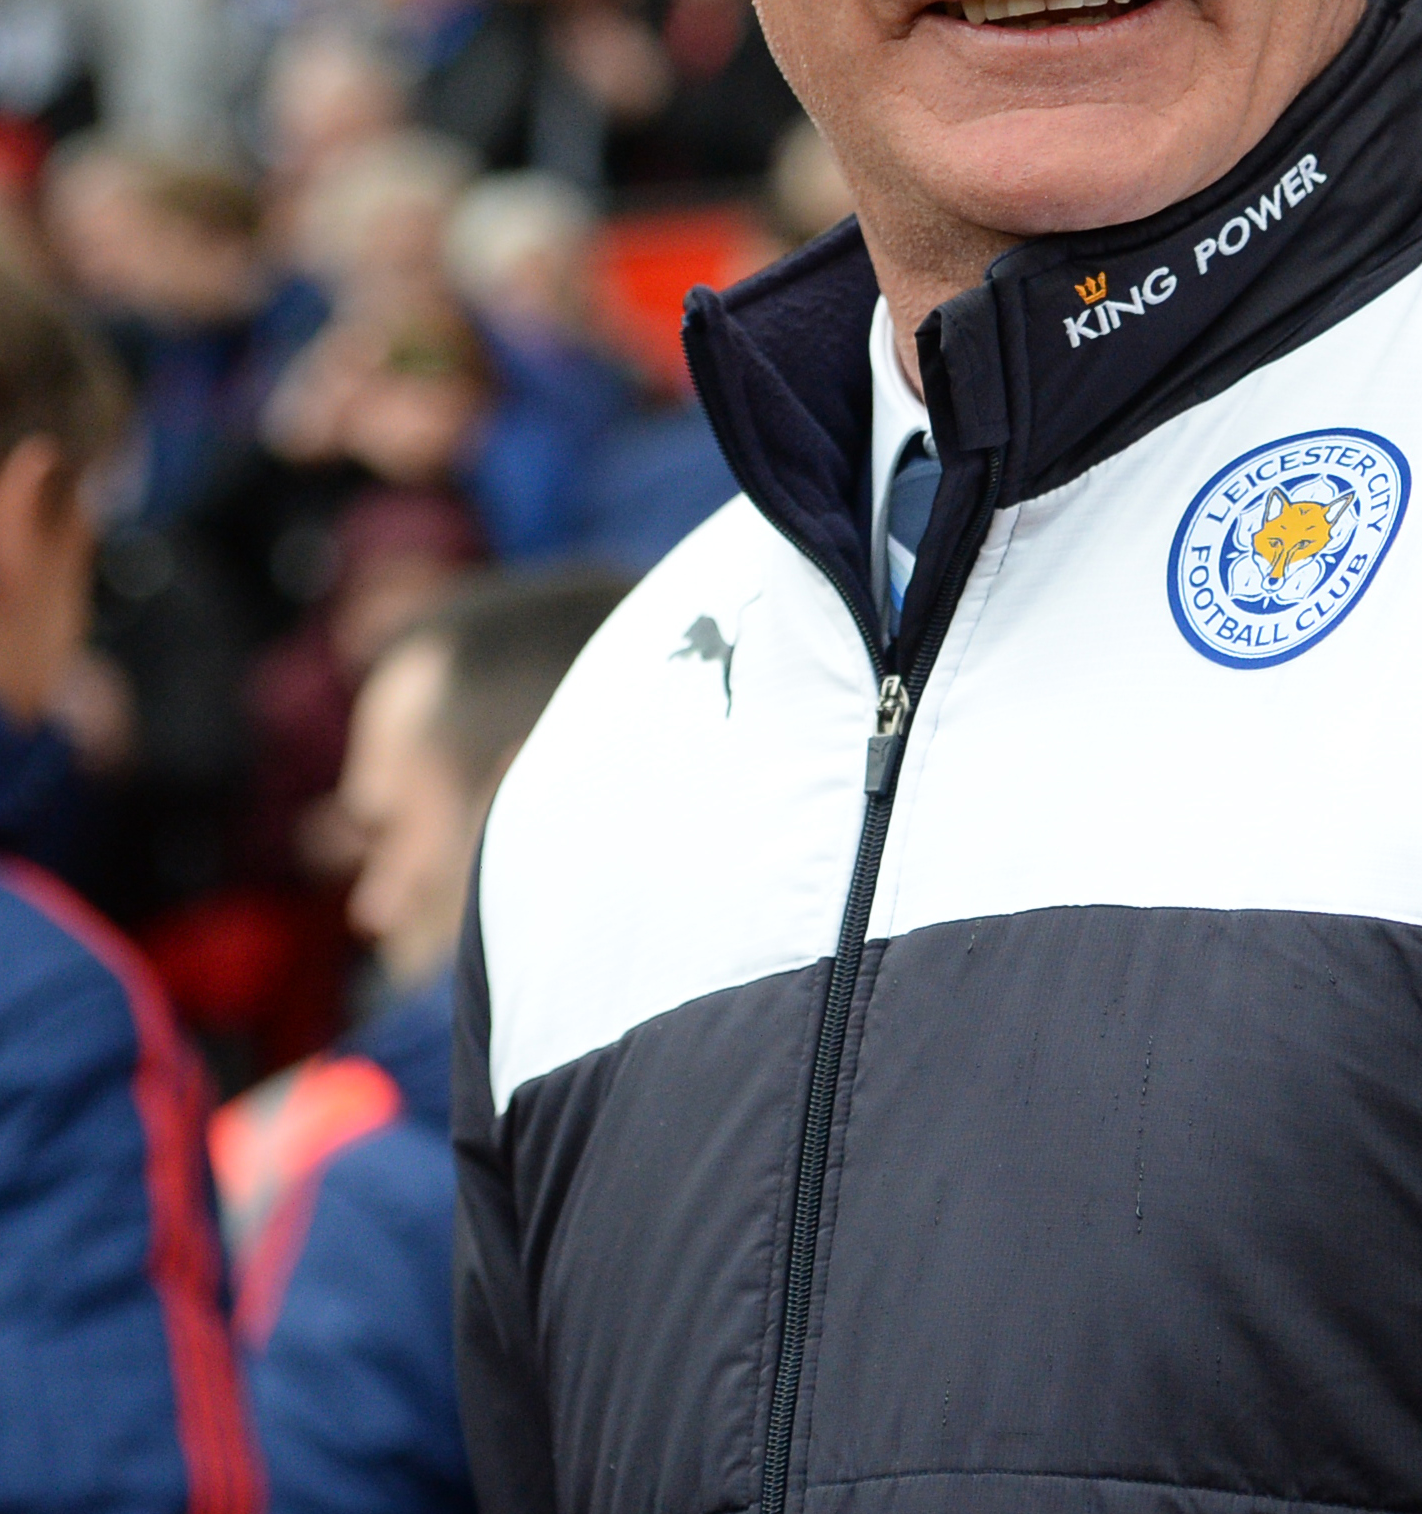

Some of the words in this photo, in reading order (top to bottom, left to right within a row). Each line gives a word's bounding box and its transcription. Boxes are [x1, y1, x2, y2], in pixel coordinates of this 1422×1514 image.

[1063, 266, 1177, 348] KING
[1193, 153, 1328, 275] POWER
[1206, 445, 1377, 524] LEICESTER
[1366, 472, 1391, 534] CITY
[1188, 544, 1290, 647] FOOTBALL
[1295, 552, 1368, 632] CLUB
